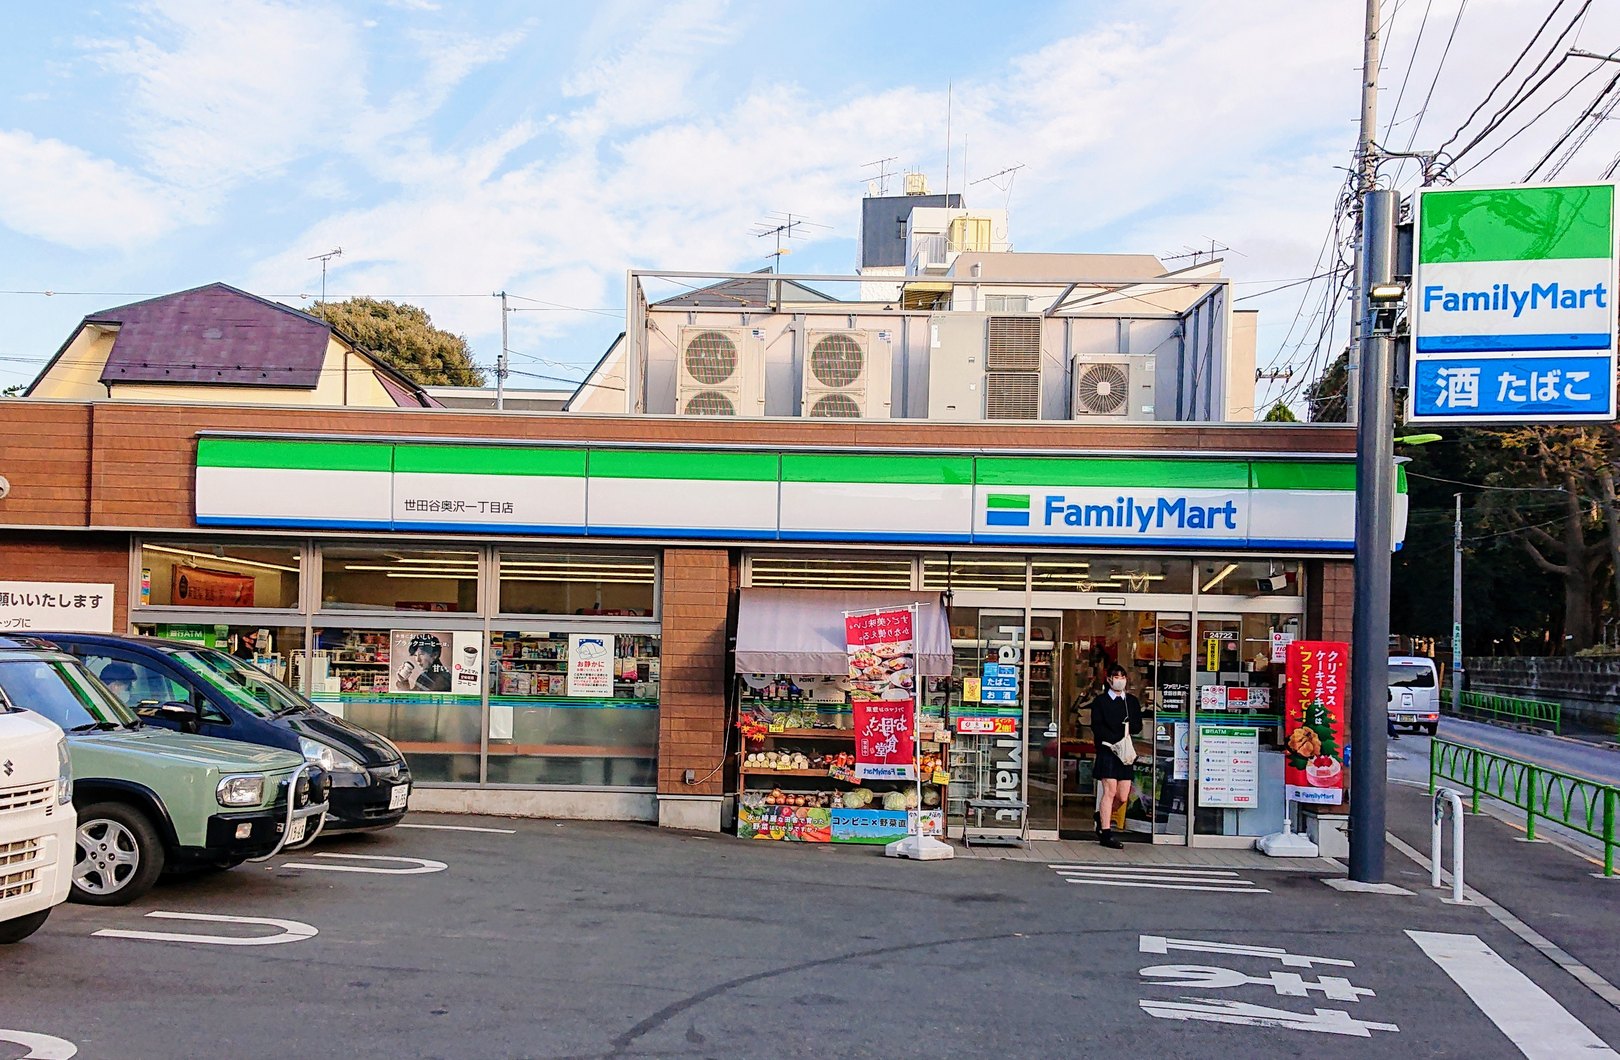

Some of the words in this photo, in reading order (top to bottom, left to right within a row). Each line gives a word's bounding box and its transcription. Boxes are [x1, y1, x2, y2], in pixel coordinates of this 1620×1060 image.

[1424, 282, 1607, 318] FamilyMart
[1435, 367, 1480, 407] 酒
[1496, 370, 1591, 402] たばこ
[404, 499, 514, 514] 世田谷奥沢一丁目店
[1044, 496, 1236, 532] FamilyMart
[987, 691, 1010, 699] お酒
[1314, 650, 1326, 725] ケーキ&チキンは
[1326, 650, 1339, 706] クリスマス
[1302, 791, 1334, 800] FamilyMart
[1139, 934, 1400, 1038] 止まれ
